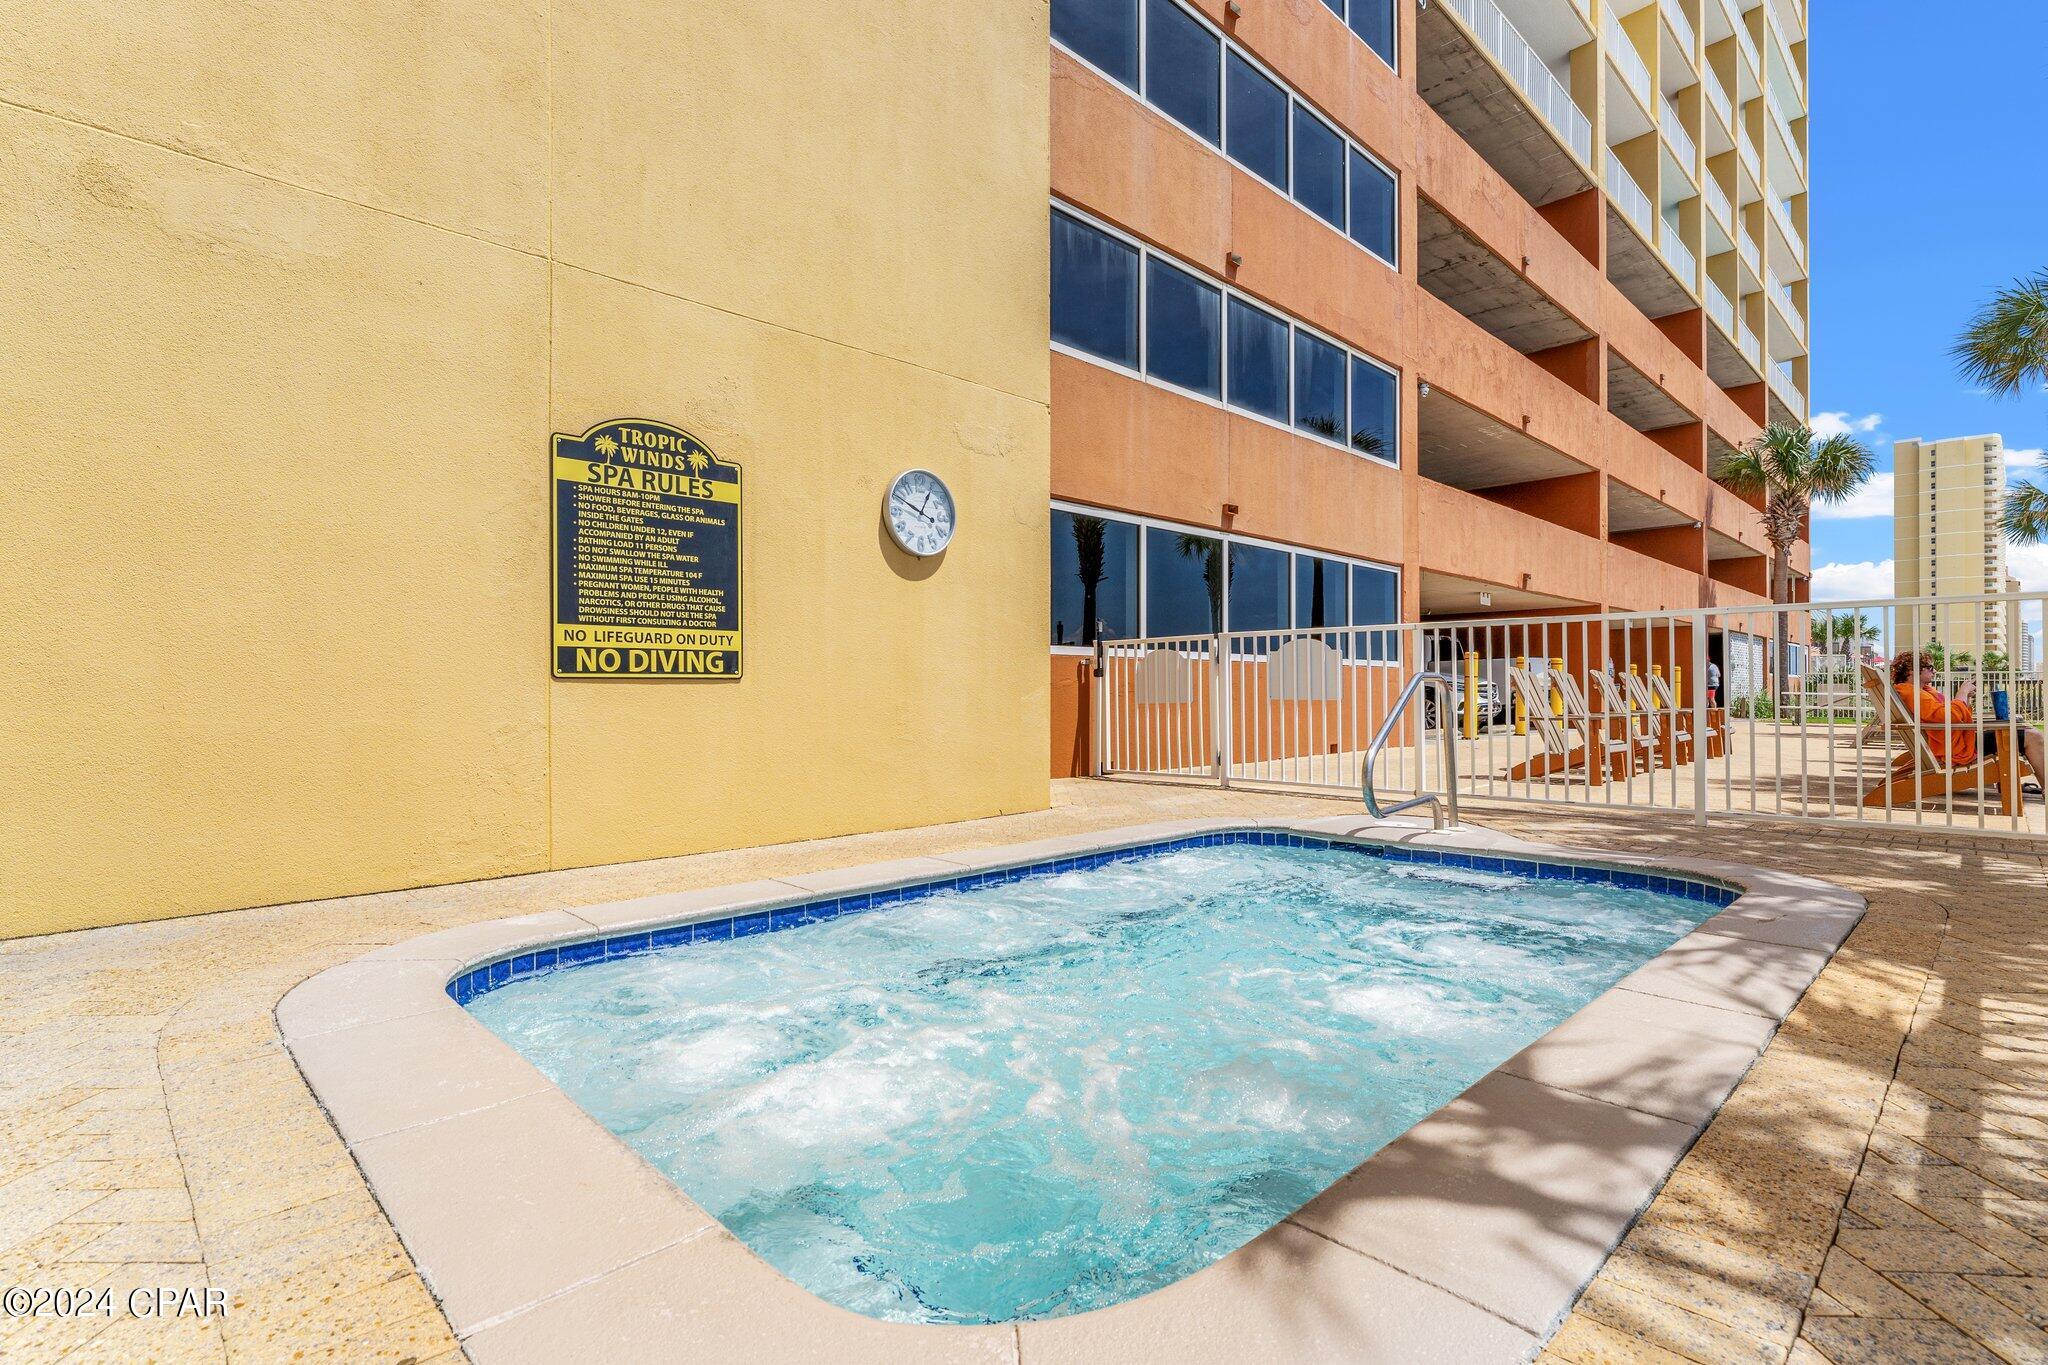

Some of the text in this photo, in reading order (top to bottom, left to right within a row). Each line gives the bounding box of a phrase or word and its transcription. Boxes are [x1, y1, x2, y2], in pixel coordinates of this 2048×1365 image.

[618, 427, 687, 453] TROPIC
[620, 447, 686, 471] WINDS
[588, 463, 714, 499] SPA RULES
[595, 487, 620, 496] HOURS
[622, 491, 660, 501] 8AM-10PM
[578, 493, 611, 503] SHOWER
[613, 498, 640, 507] BEFORE
[642, 502, 676, 511] ENTERING
[579, 511, 604, 519] INSIDE
[621, 516, 644, 524] GATES
[592, 504, 615, 513] FOOD,
[617, 507, 660, 518] BEVERAGES,
[662, 513, 683, 521] GLASS
[696, 517, 725, 525] ANIMALS
[592, 521, 629, 531] CHILDREN
[579, 528, 633, 540] ACCOMPANIED
[578, 537, 612, 546] BATHING
[645, 544, 677, 552] PERSONS
[592, 555, 633, 564] SWIMMING
[610, 549, 646, 558] SWALLOW
[578, 563, 618, 572] MAXIMUM
[634, 567, 684, 577] TEMPERATURE
[578, 572, 617, 580] MAXIMUM
[578, 580, 619, 589] PREGNANT
[621, 584, 651, 592] WOMEN,
[579, 589, 619, 597] PROBLEMS
[579, 598, 623, 607] NARCOTICS,
[579, 606, 628, 615] DROWSINESS
[564, 630, 733, 646] NO LIFEGUARD ON DUTY
[576, 648, 724, 673] NO DIVING
